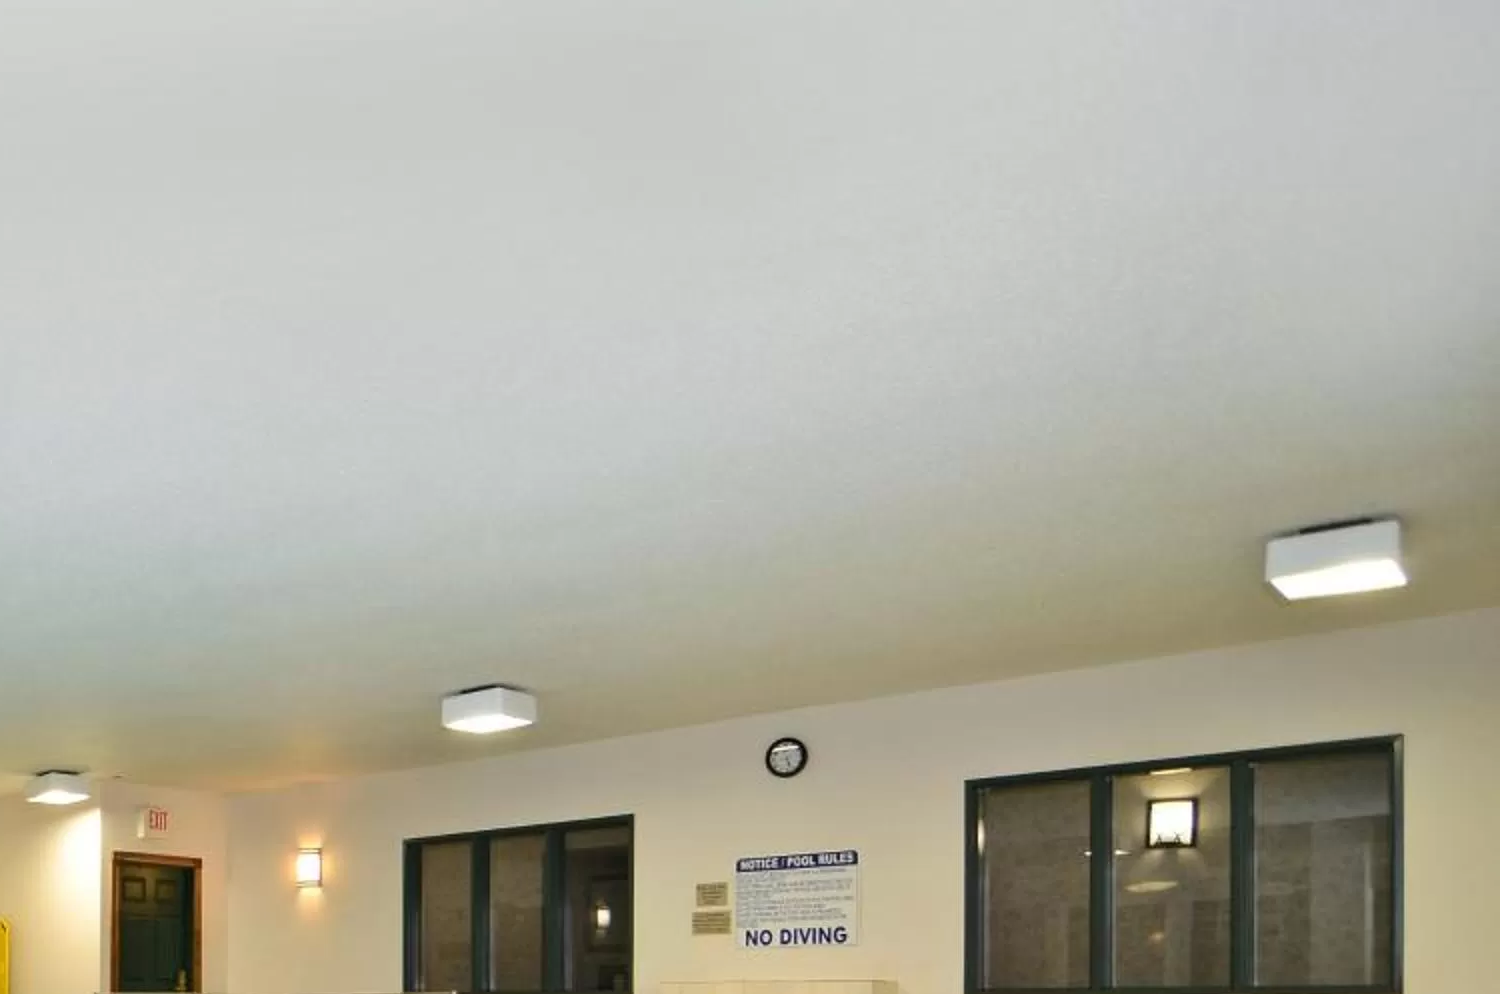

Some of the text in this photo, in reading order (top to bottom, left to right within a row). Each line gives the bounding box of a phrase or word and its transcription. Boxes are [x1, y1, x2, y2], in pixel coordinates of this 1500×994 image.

[149, 809, 168, 831] EXIT
[739, 858, 779, 872] NOTICE
[787, 855, 816, 868] POOL
[818, 852, 853, 865] RULES
[745, 926, 848, 947] NO DIVING
